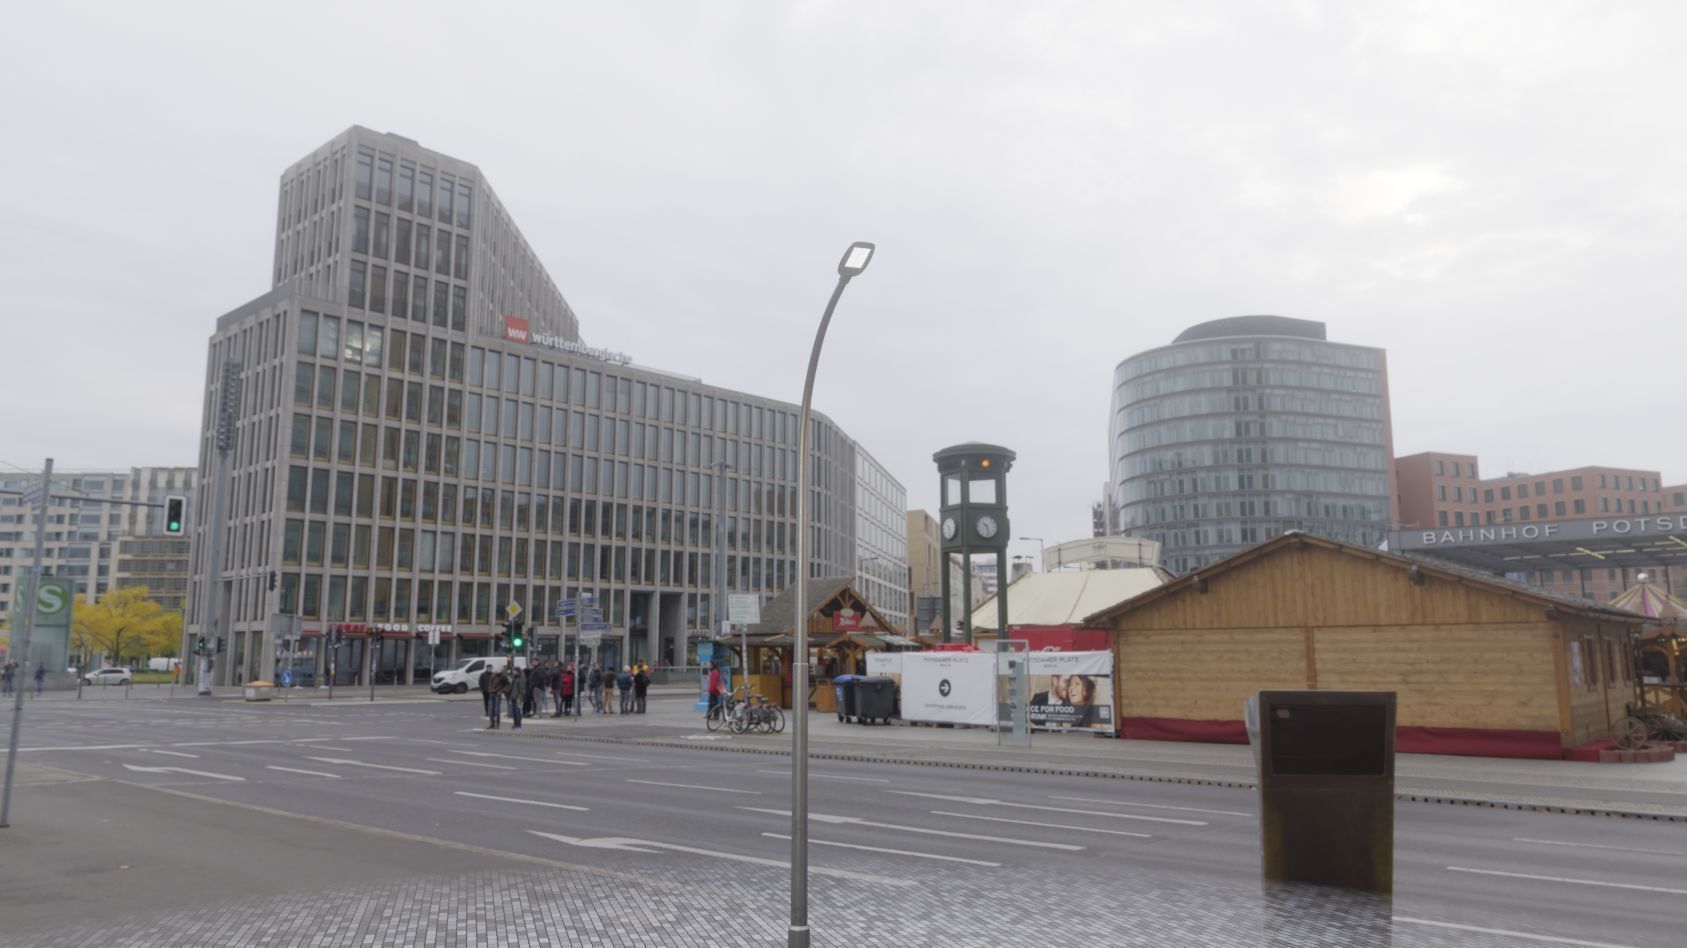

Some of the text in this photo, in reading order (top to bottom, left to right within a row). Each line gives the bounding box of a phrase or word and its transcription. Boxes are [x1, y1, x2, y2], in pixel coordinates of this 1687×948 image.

[1423, 523, 1560, 545] BAHNHOF
[38, 585, 63, 613] S
[418, 623, 453, 632] COFFEE
[1059, 656, 1080, 664] PLATZ
[1040, 705, 1055, 713] FOR
[1055, 705, 1076, 714] FOOD
